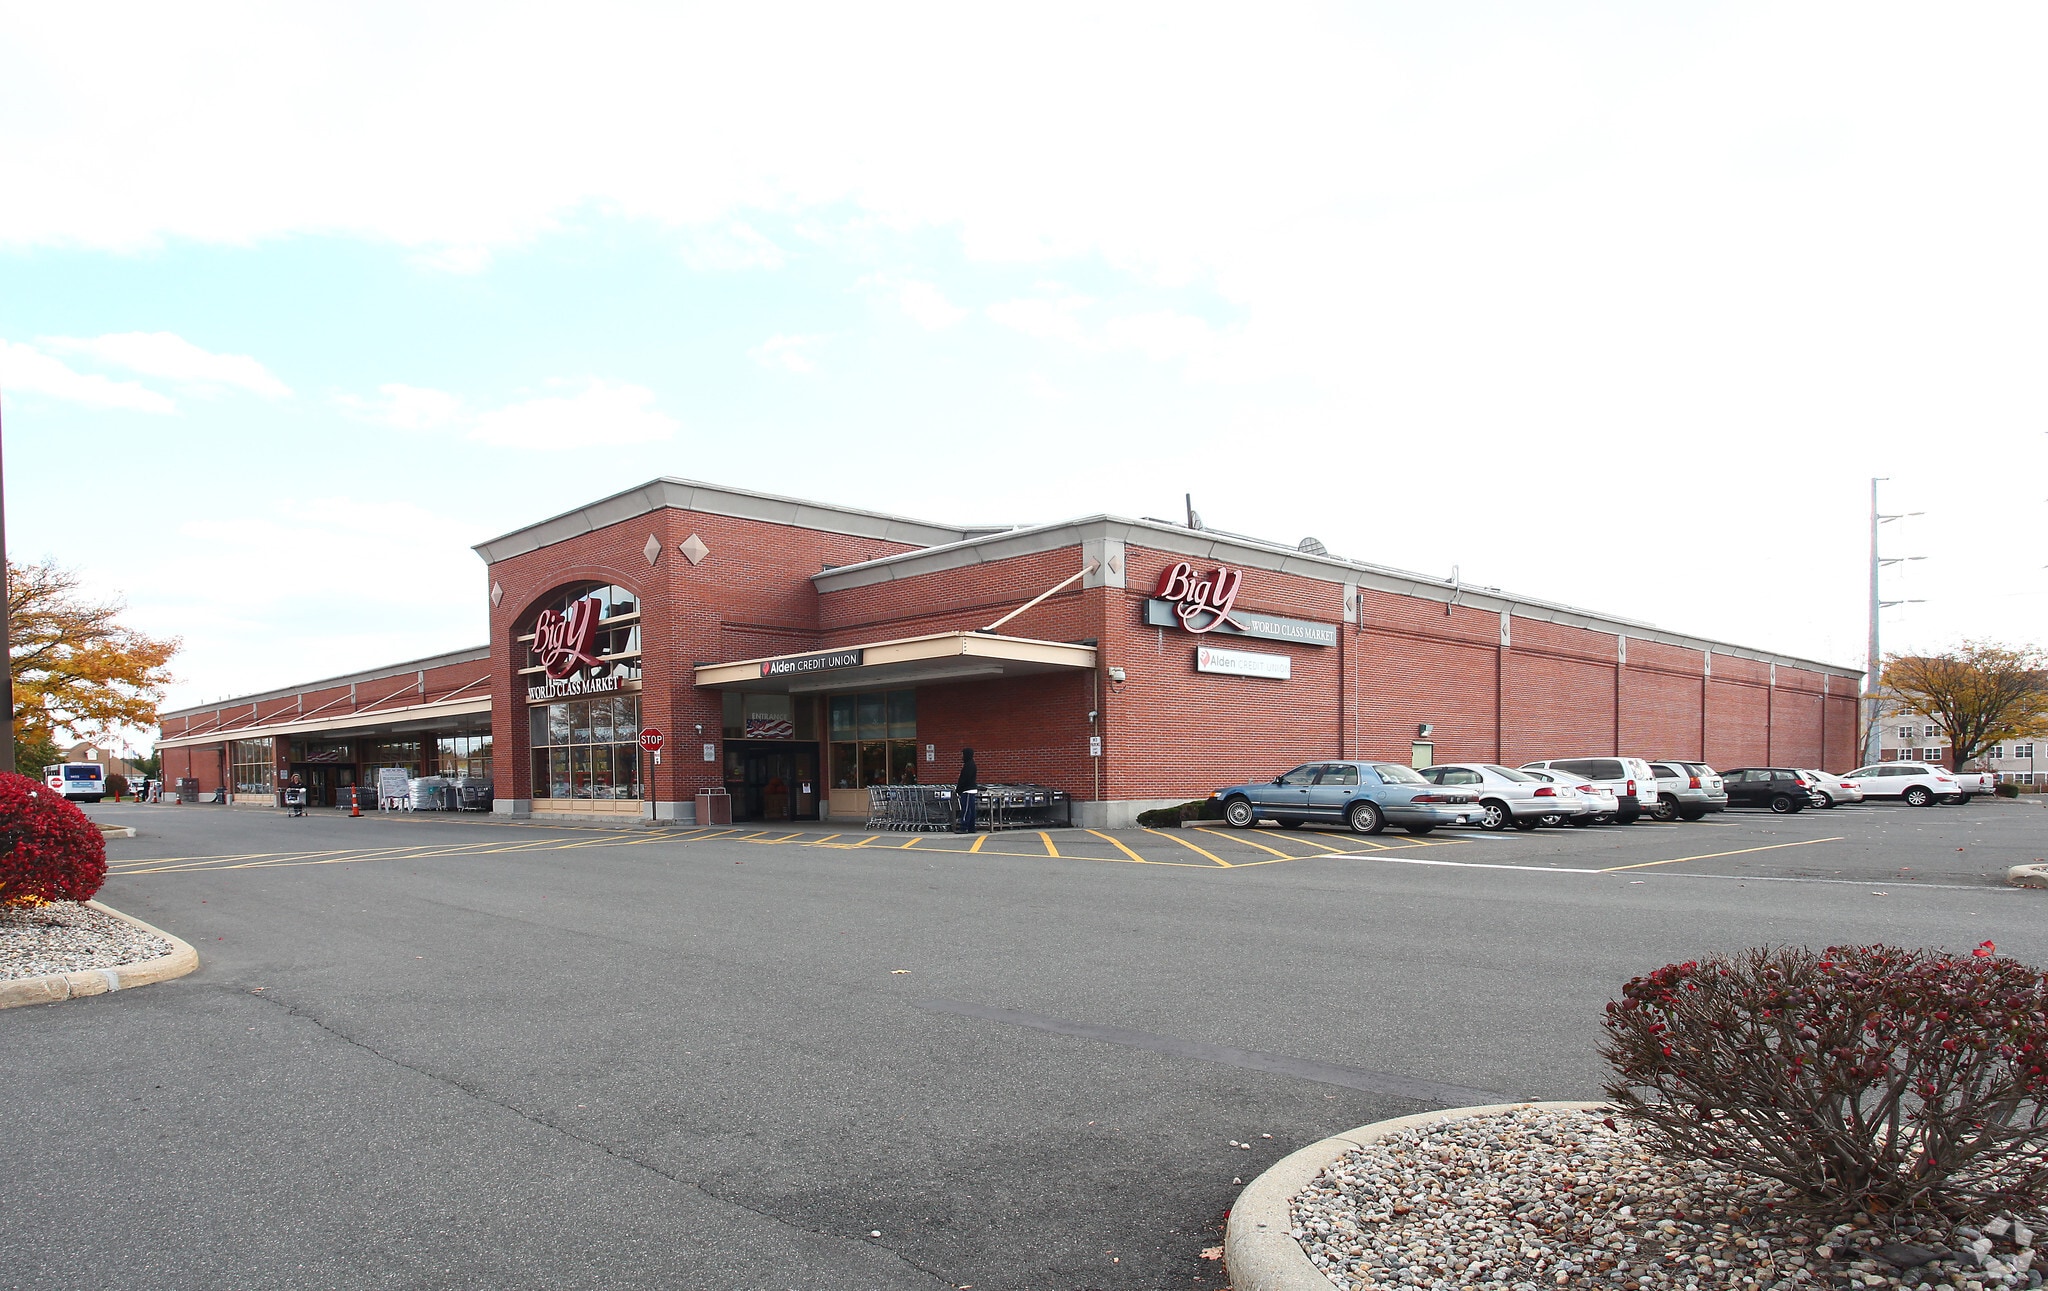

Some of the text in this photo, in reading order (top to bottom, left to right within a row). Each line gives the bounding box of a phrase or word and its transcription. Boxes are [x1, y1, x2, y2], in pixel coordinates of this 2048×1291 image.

[1251, 620, 1334, 642] WORLD CLASS MARKET
[770, 654, 857, 674] Alden CREDIT UNION
[1210, 655, 1236, 668] Alden
[1238, 659, 1264, 671] CREDIT
[528, 676, 619, 700] WORLD CLASS MARKET
[751, 712, 788, 720] ENTRANCE
[641, 735, 662, 745] STOP
